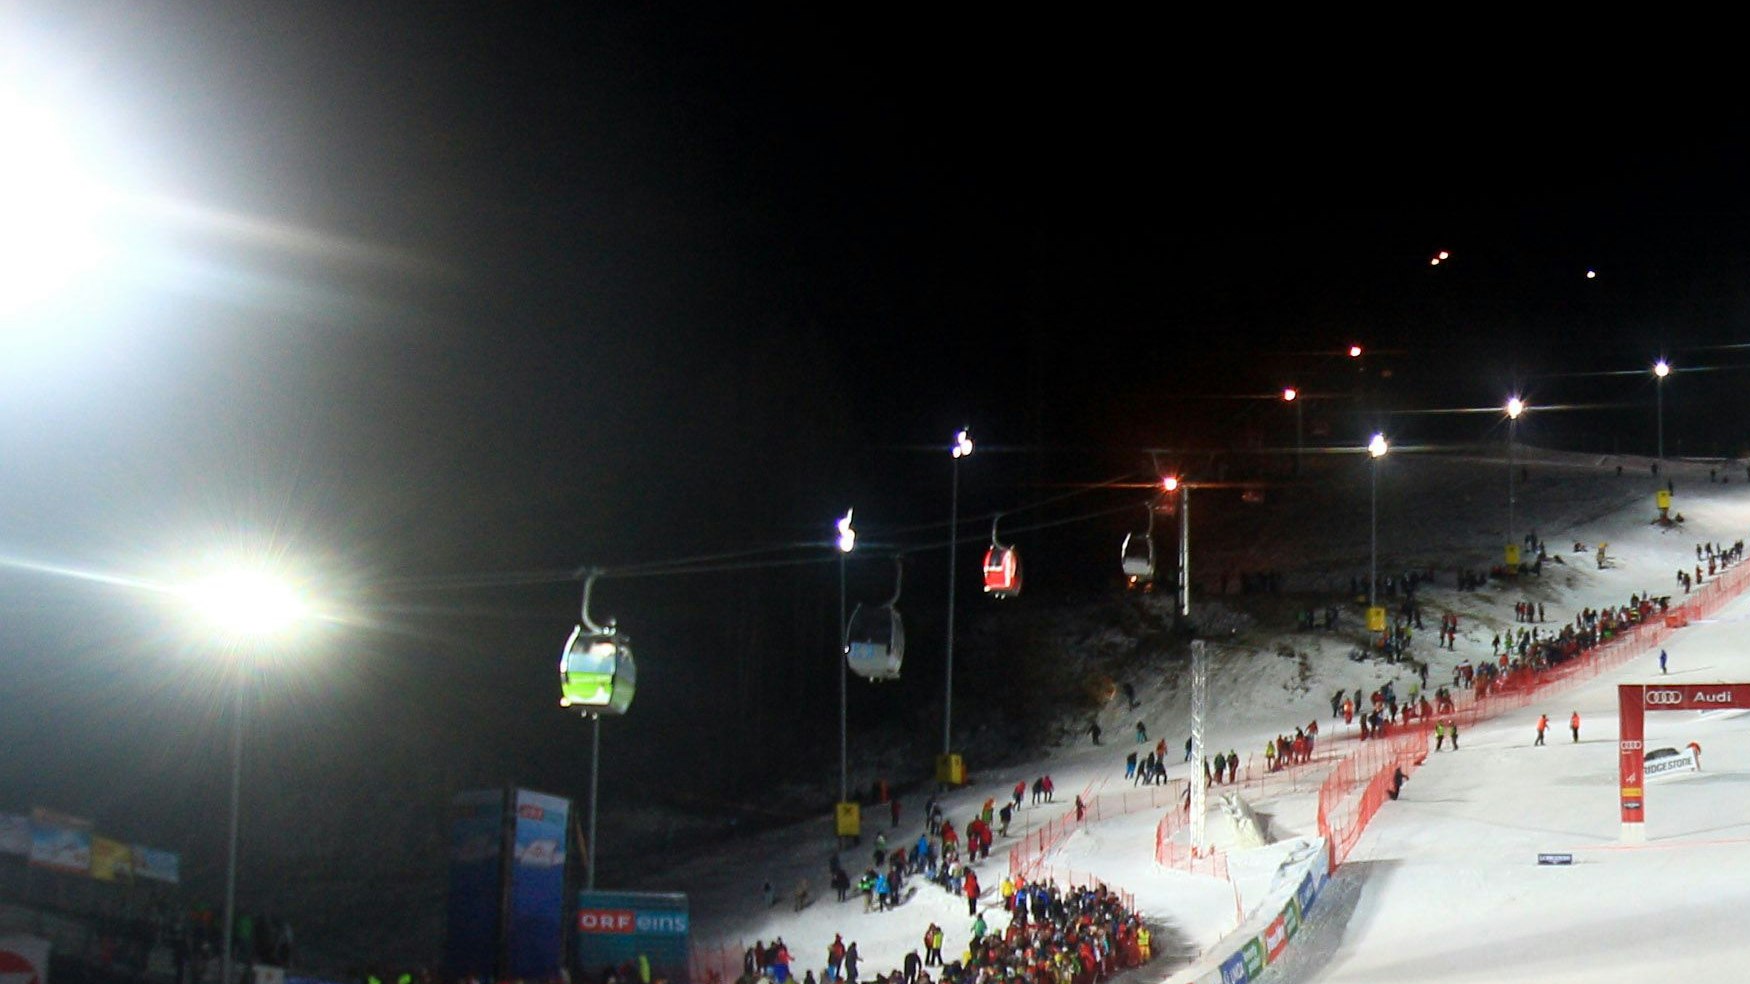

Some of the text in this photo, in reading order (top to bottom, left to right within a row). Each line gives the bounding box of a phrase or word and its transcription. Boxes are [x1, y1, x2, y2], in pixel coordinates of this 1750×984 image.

[1693, 691, 1731, 703] Audi
[581, 913, 687, 932] ORF eins
